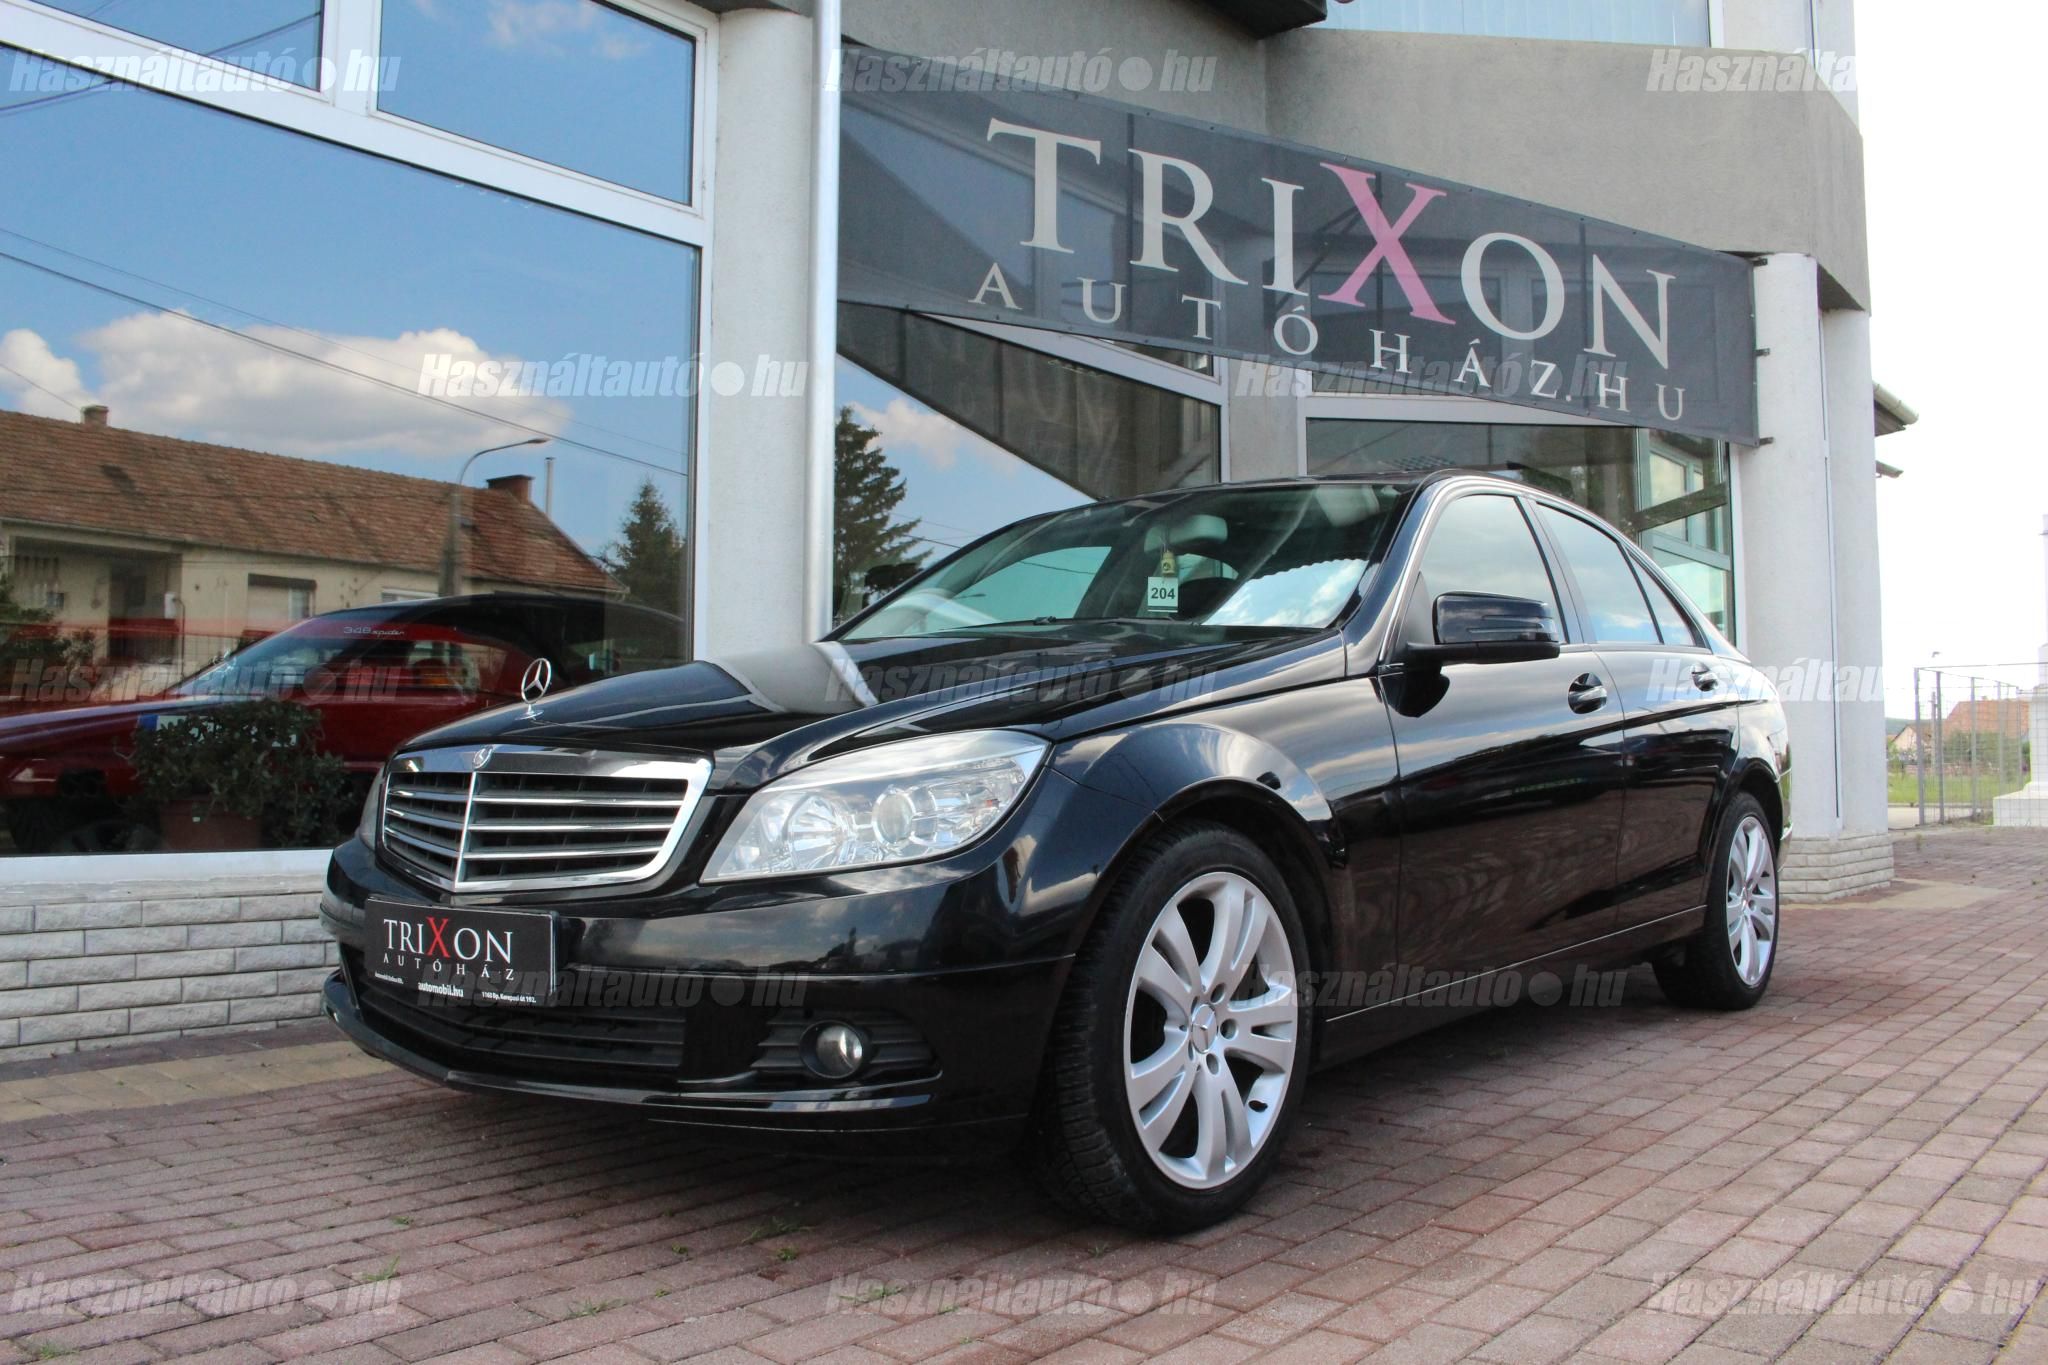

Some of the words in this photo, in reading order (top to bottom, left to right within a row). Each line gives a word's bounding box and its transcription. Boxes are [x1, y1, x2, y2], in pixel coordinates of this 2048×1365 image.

[986, 117, 1676, 370] TRIXON
[1150, 587, 1176, 600] 204
[383, 916, 513, 964] TRIXON
[383, 953, 515, 981] AUTÓHÁZ
[417, 982, 464, 998] automobil.hu
